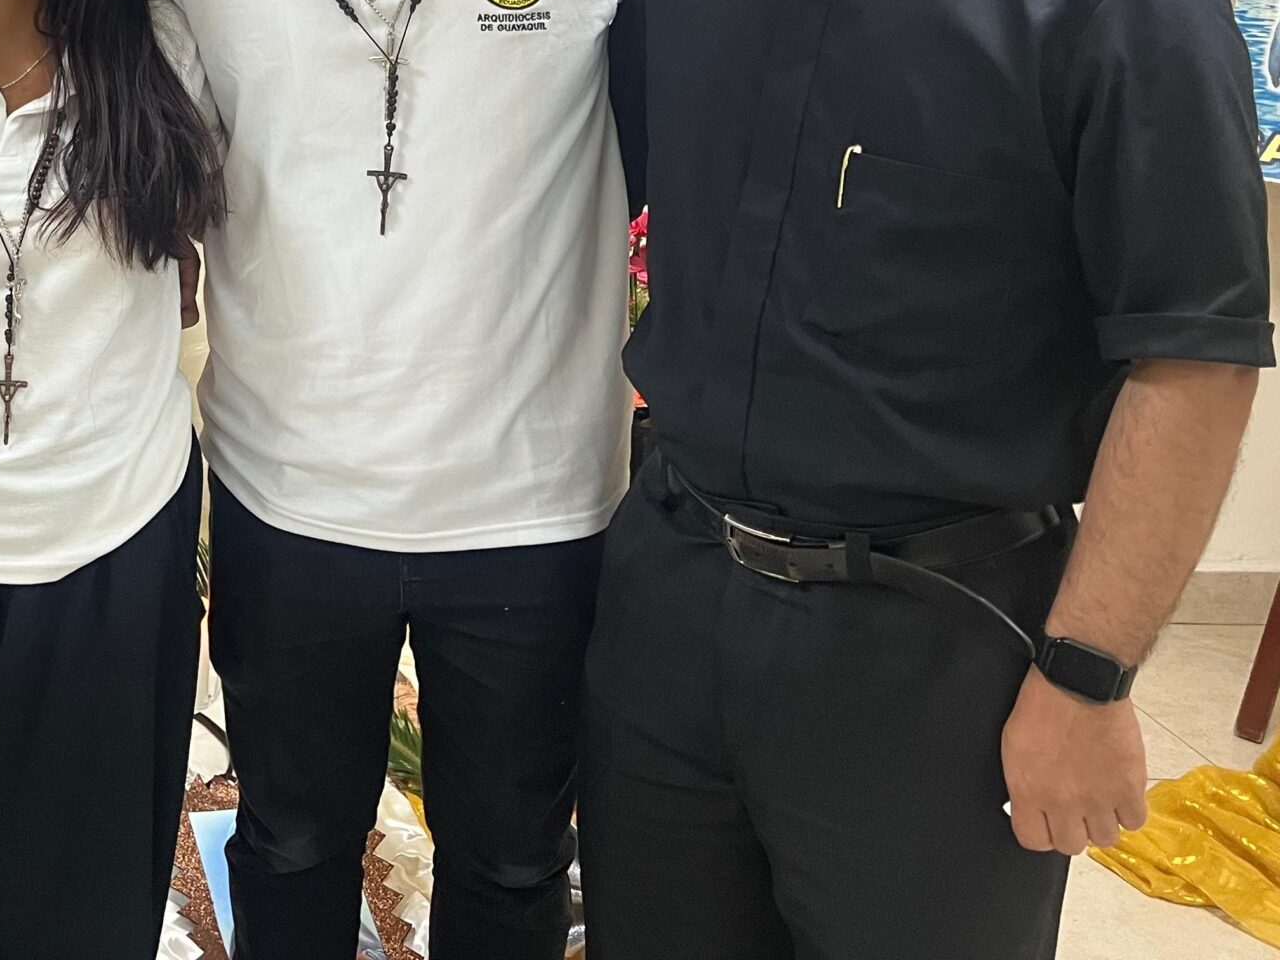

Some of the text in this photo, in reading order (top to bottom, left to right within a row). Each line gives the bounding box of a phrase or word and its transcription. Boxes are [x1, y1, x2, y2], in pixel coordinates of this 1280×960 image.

[477, 11, 551, 23] ARQUIDIOCESIS
[480, 22, 547, 32] DE GUAYAQUIL
